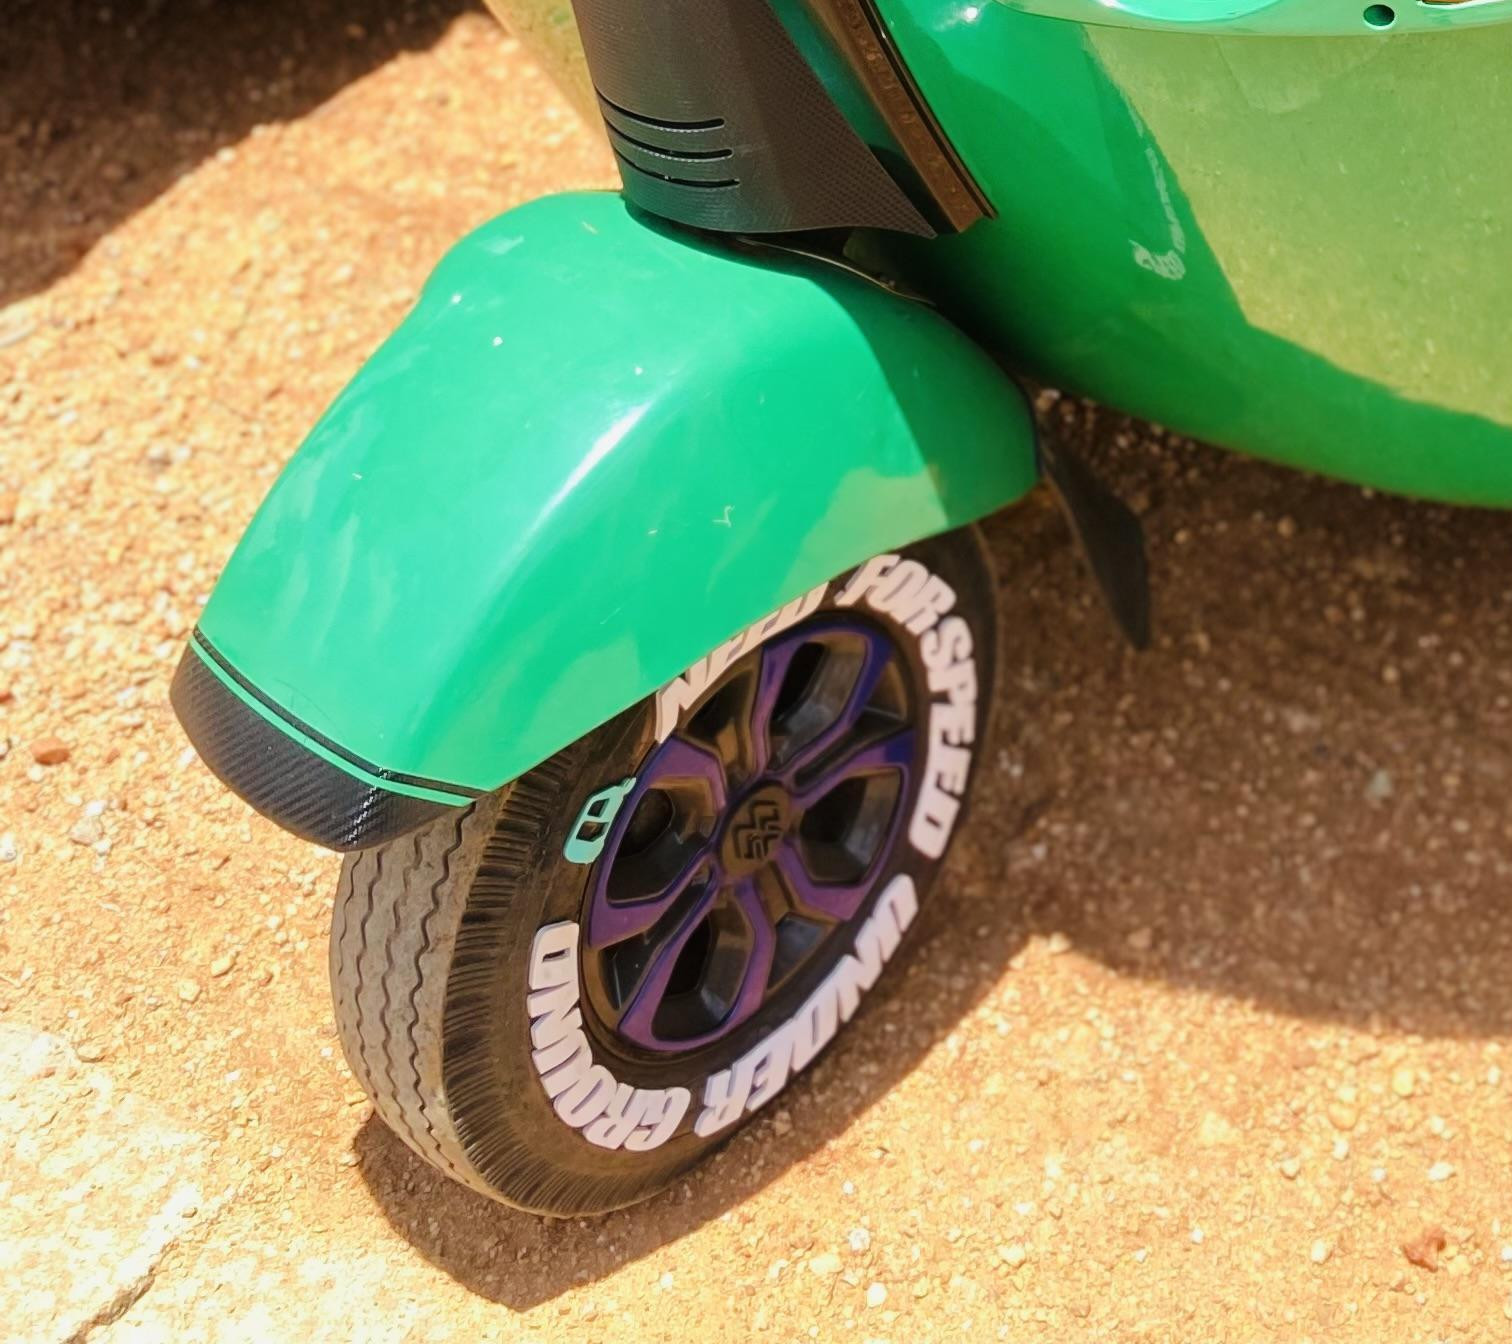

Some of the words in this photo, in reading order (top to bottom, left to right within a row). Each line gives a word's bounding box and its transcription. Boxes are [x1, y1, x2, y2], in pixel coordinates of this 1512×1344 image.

[834, 554, 957, 637] FOR
[907, 616, 978, 860] SPEED
[526, 919, 692, 1152] GROUND
[694, 874, 919, 1139] UNDER
